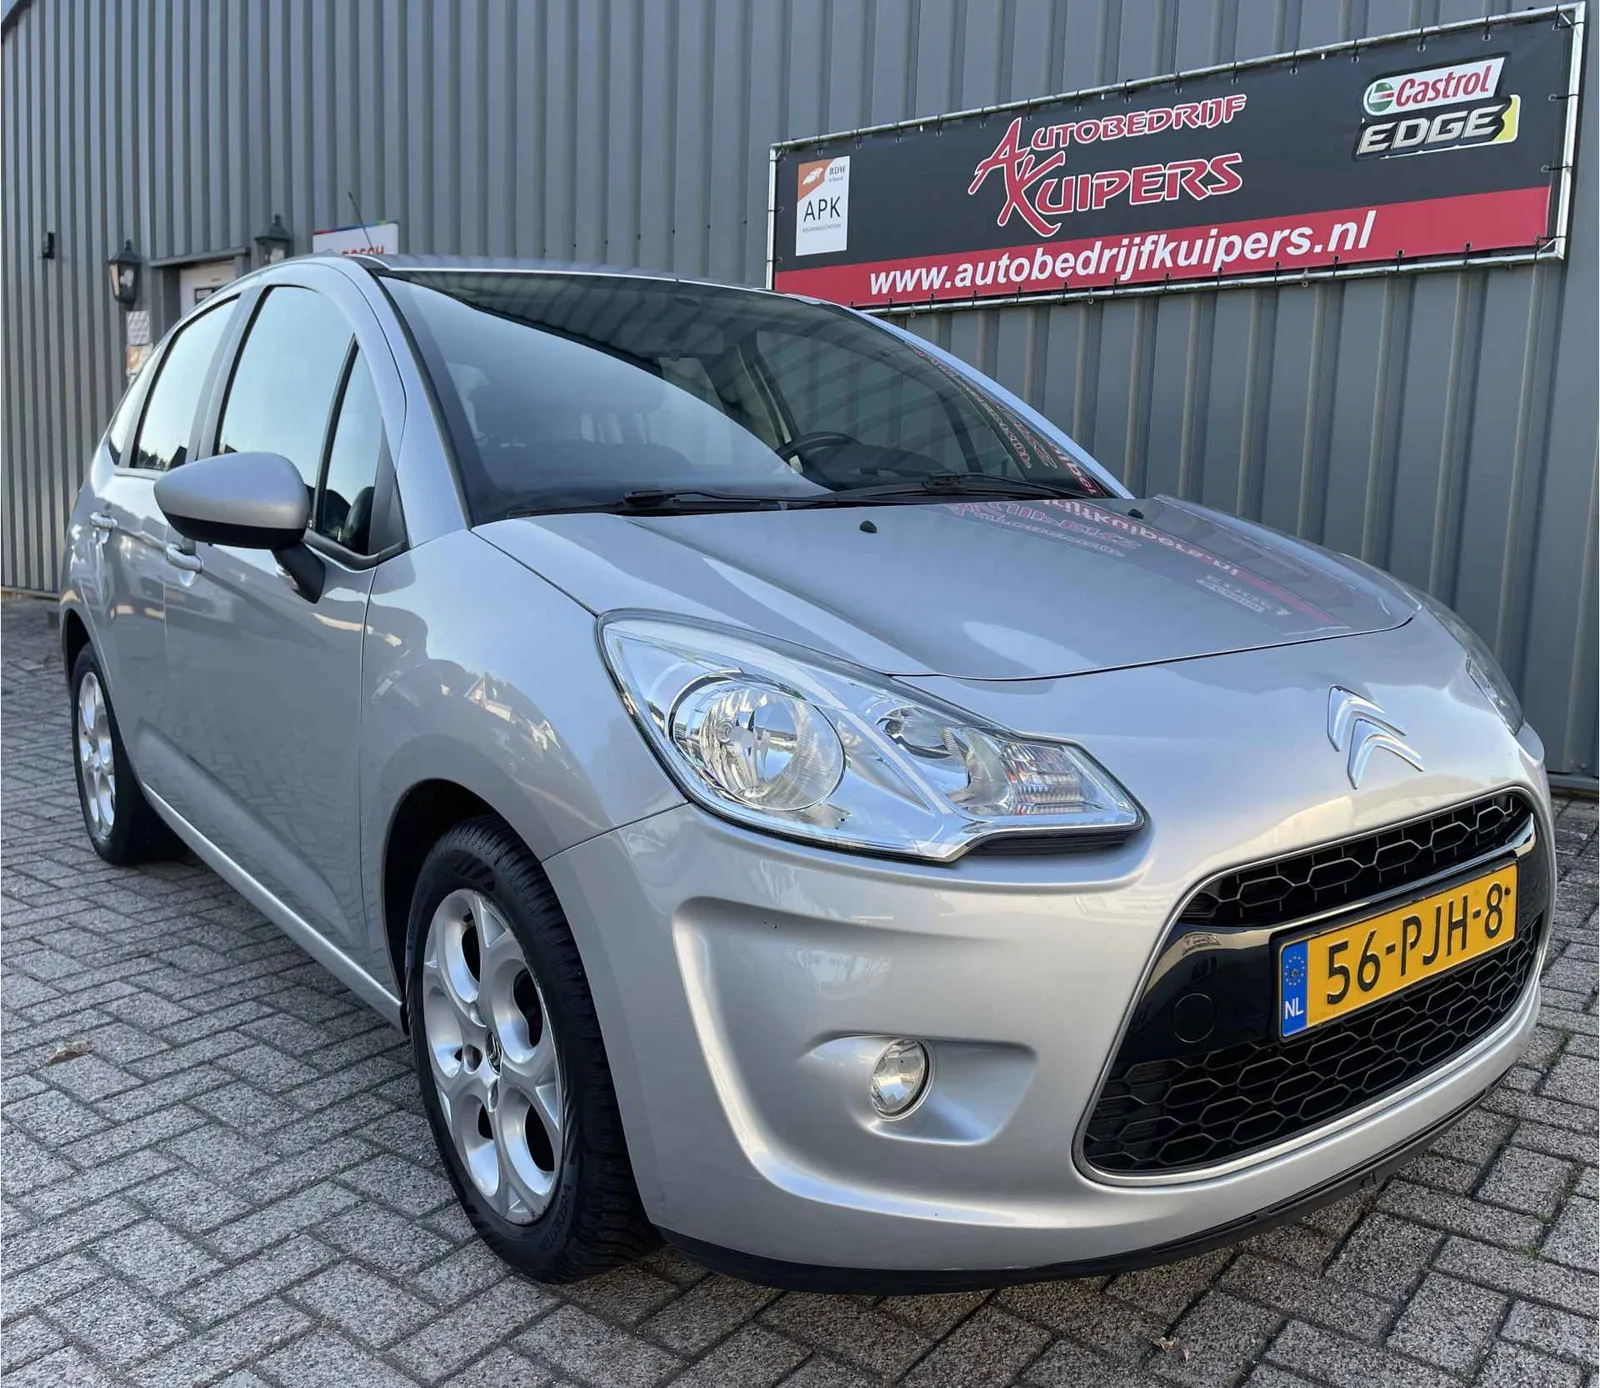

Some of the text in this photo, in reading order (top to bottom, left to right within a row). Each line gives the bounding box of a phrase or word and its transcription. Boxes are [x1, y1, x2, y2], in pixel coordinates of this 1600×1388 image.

[1396, 64, 1492, 107] Castrol
[968, 95, 1247, 195] AUTOBEDRIJF
[1356, 104, 1506, 155] EDGE
[829, 165, 846, 175] RDW
[997, 151, 1243, 237] KUIPERS
[803, 196, 841, 222] APK
[869, 210, 1377, 295] www.autobedrijfkuipers.nl
[1326, 882, 1503, 1005] 56-PJH-8
[1284, 997, 1303, 1020] NL
